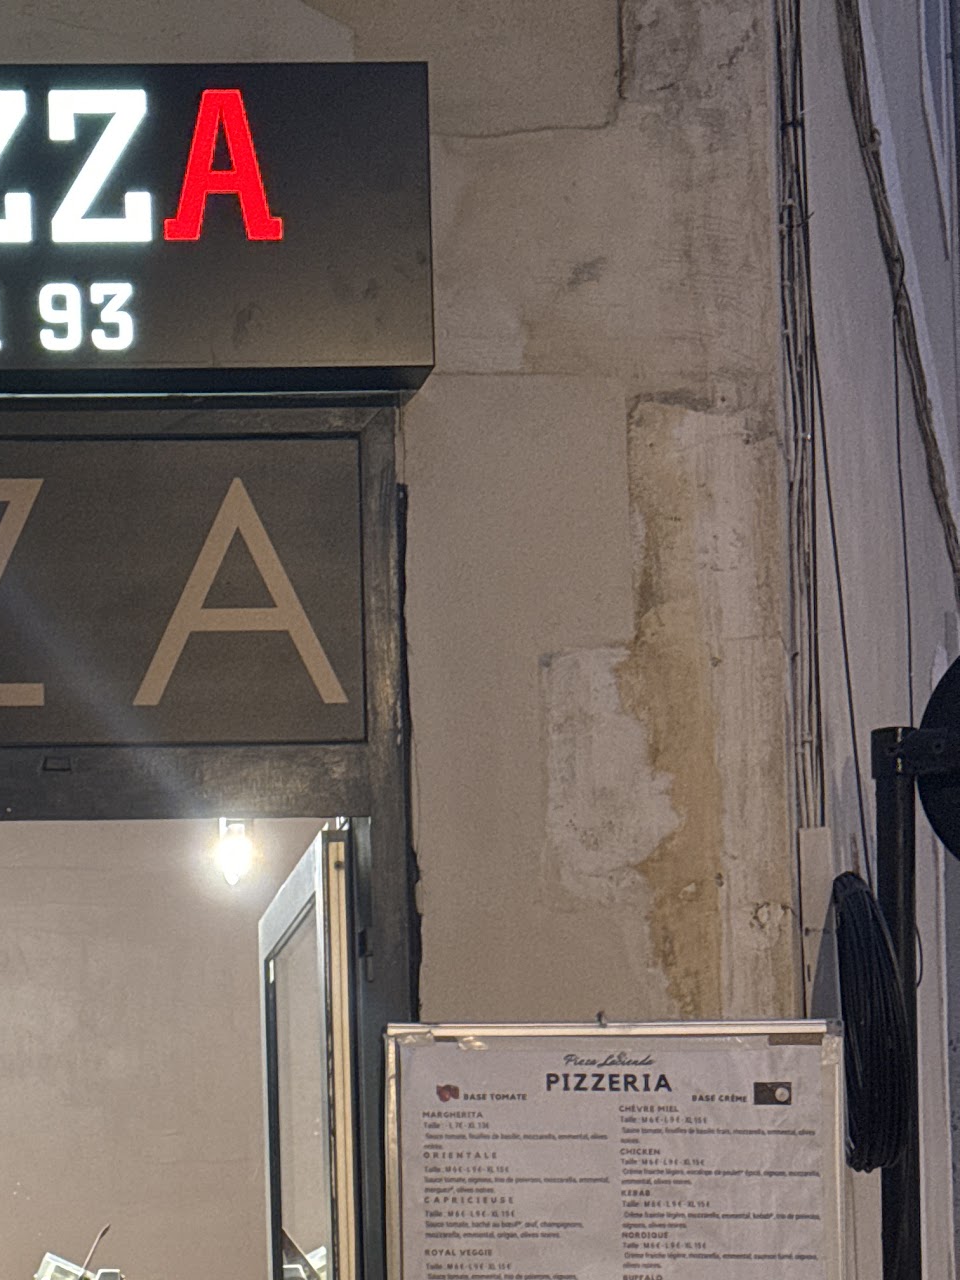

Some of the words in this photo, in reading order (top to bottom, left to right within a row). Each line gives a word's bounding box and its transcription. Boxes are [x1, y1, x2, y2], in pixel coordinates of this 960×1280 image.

[37, 281, 136, 355] 93
[545, 1073, 672, 1092] PIZZERIA
[424, 1196, 513, 1204] CAPRICIEUSE
